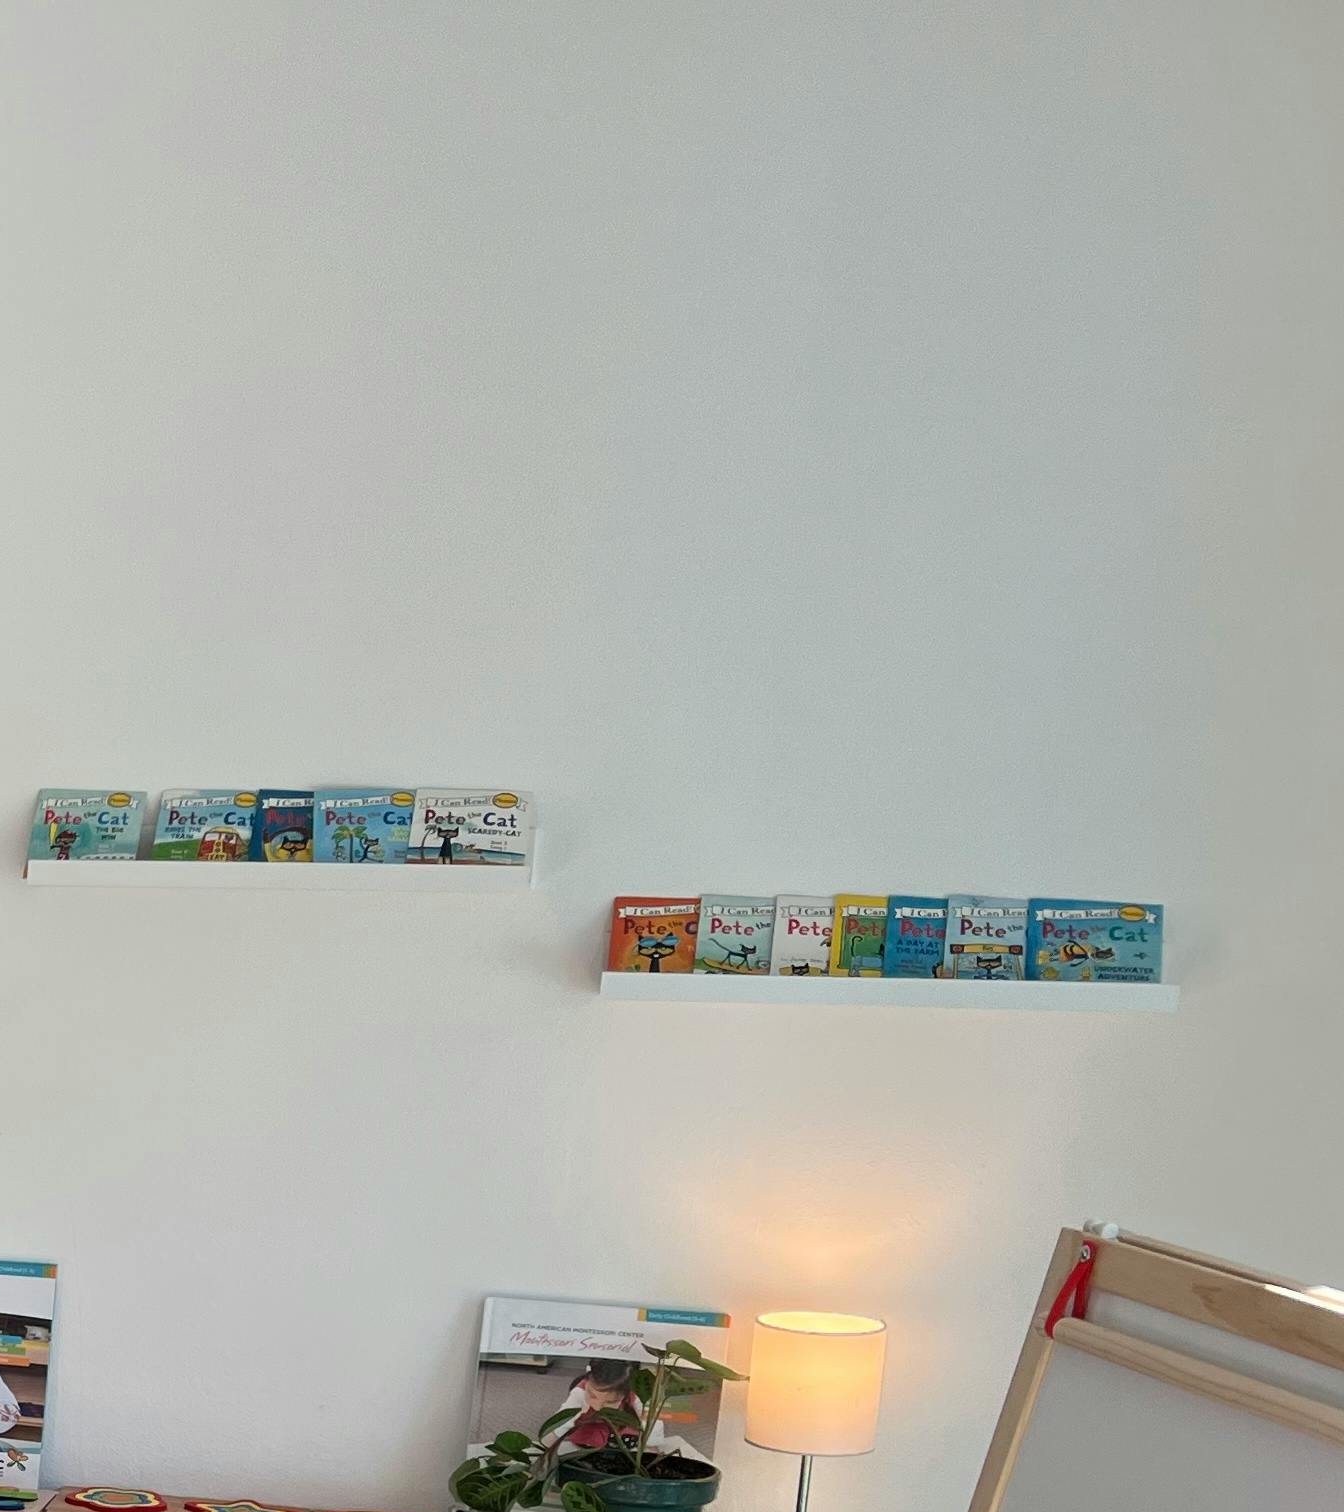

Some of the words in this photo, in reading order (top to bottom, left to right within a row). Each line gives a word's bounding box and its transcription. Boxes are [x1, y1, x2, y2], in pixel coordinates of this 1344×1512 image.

[44, 809, 82, 825] Pete
[97, 811, 130, 826] Cat
[168, 810, 208, 826] Pete
[223, 811, 256, 827] Cat
[325, 811, 367, 826] Pete
[424, 809, 466, 825] Pete
[483, 812, 518, 828] Cat
[640, 907, 661, 915] Can
[728, 907, 748, 915] Can
[623, 918, 667, 935] Pete
[668, 920, 683, 929] the
[710, 917, 755, 936] Pete
[755, 921, 771, 930] the
[787, 918, 832, 936] Pete
[960, 918, 1007, 938] Pete
[1007, 924, 1024, 932] the
[1042, 920, 1090, 940] Pete
[1108, 926, 1149, 942] Cat
